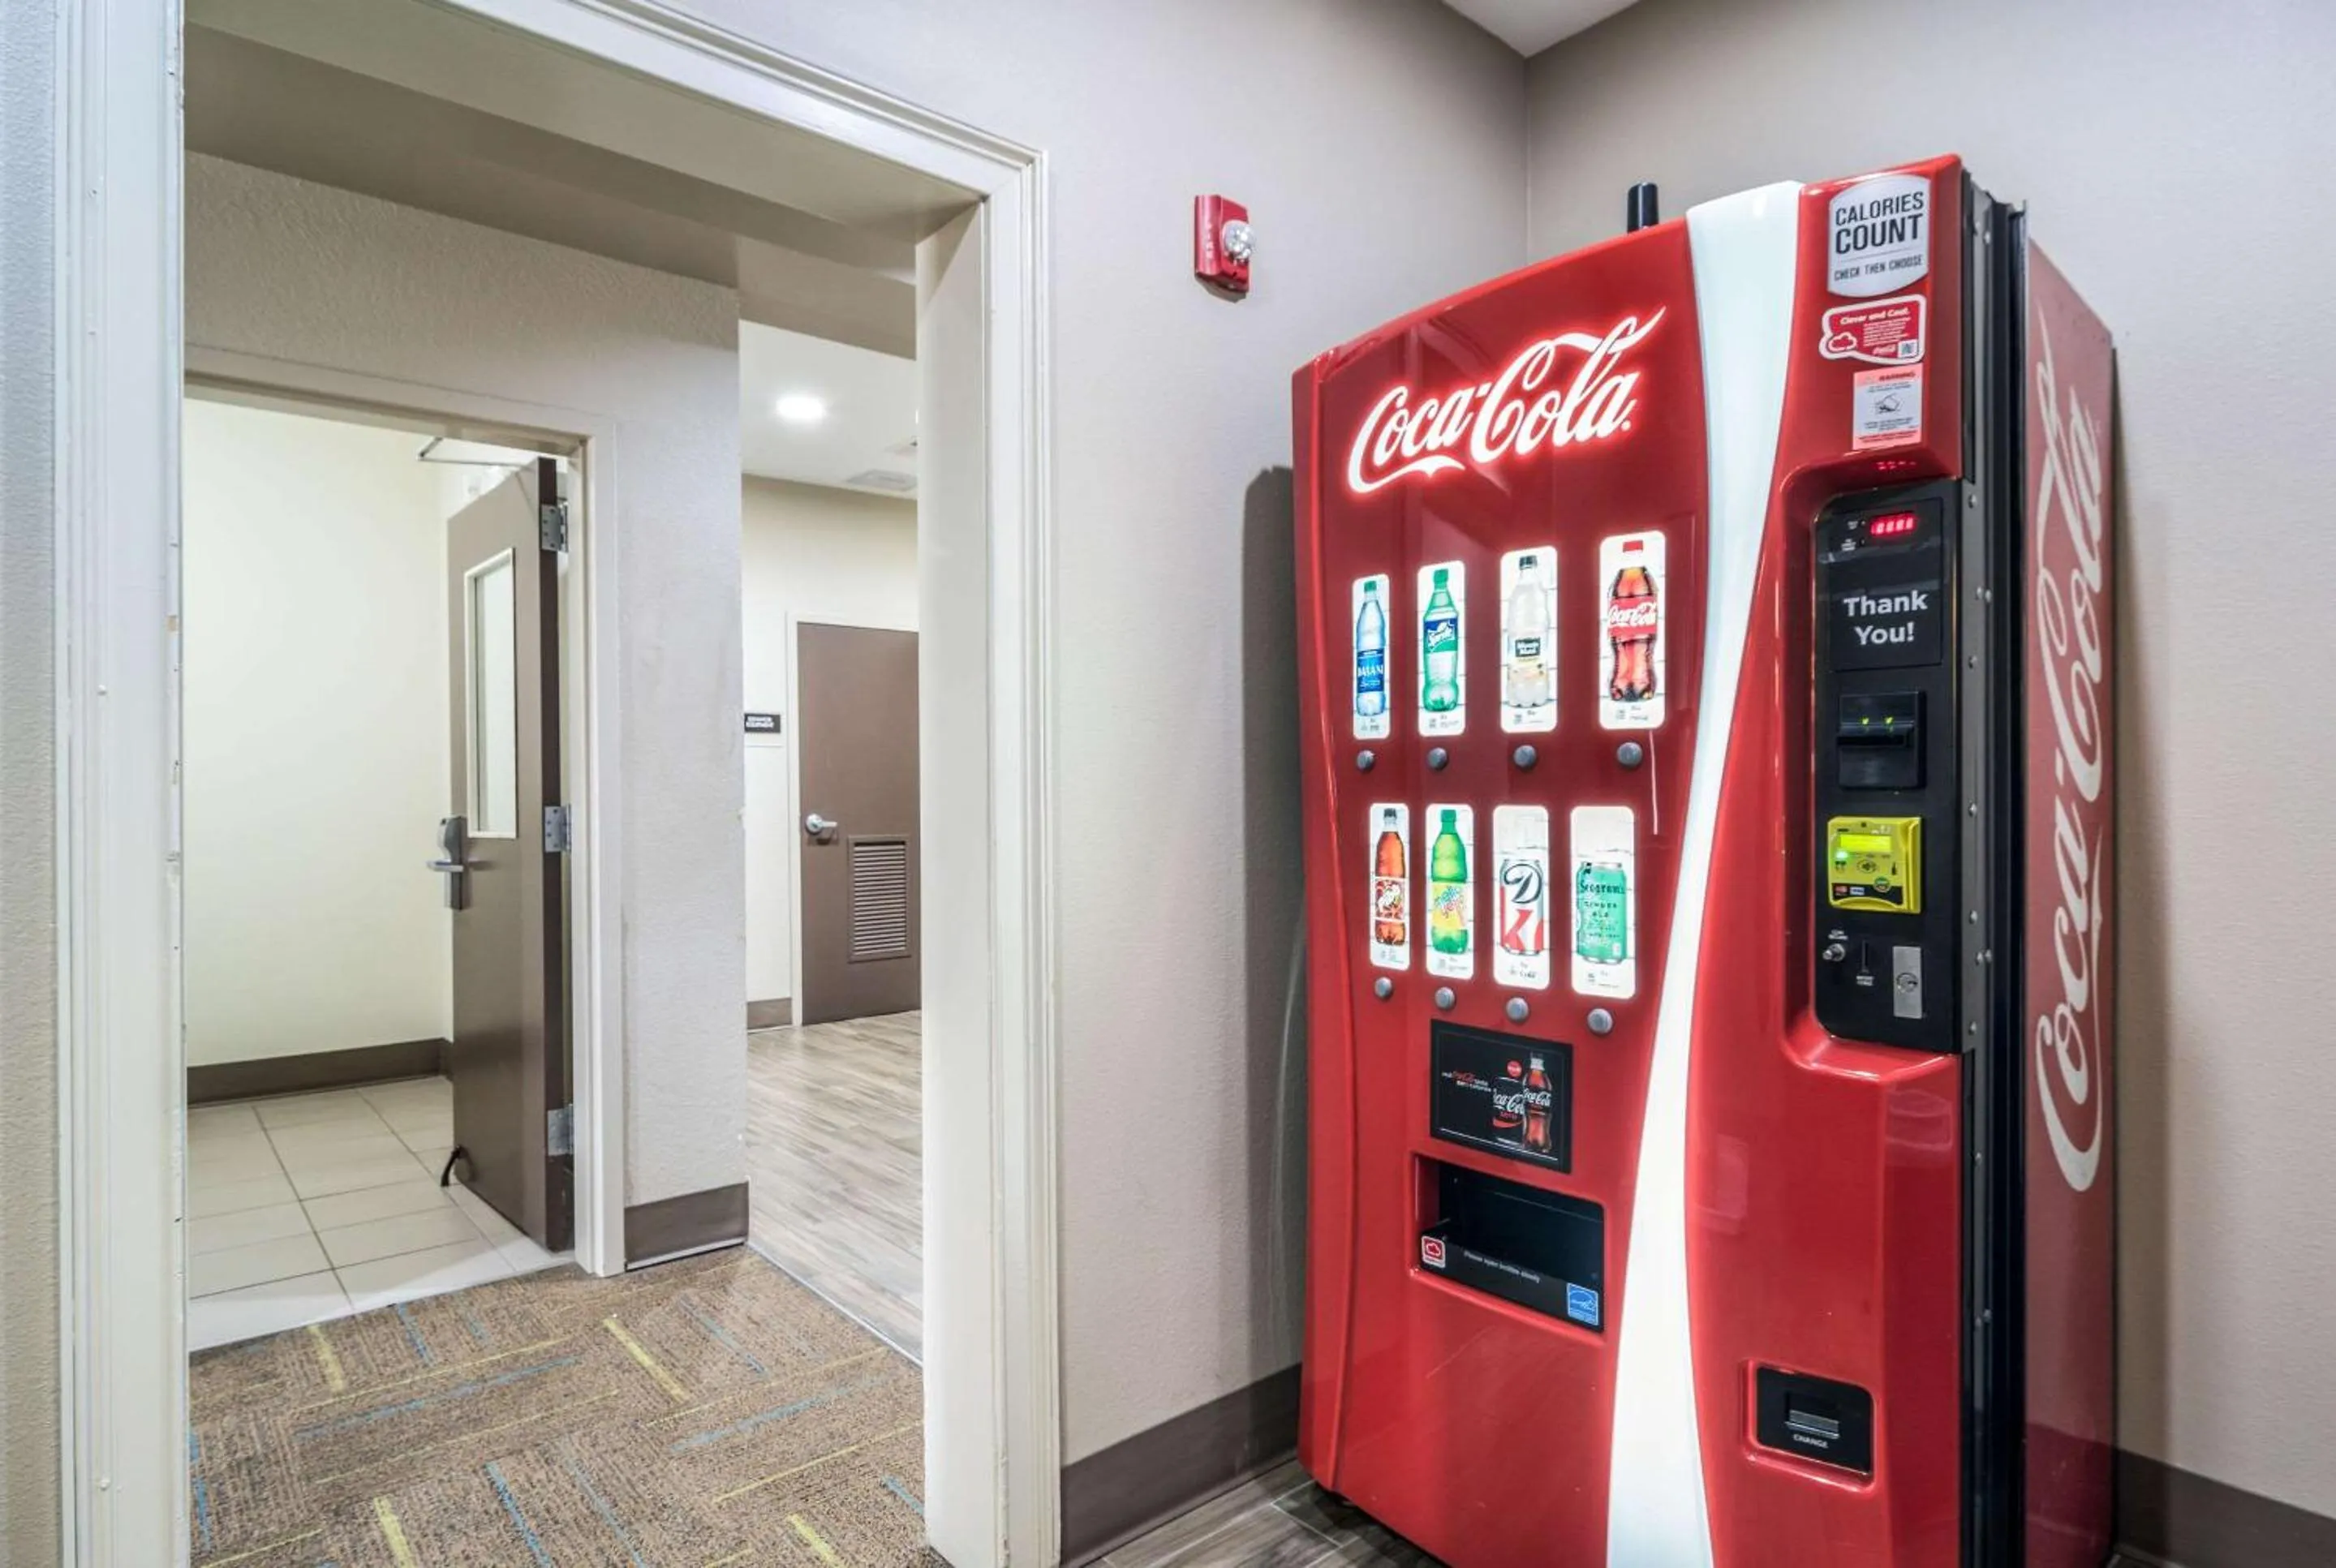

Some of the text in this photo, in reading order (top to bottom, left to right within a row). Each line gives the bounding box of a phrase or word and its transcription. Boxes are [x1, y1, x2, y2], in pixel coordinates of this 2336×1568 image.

[1835, 191, 1924, 226] CALORIES
[1835, 213, 1923, 255] COUNT
[1835, 255, 1923, 281] CHECK THEN CHOOSE
[1348, 306, 1667, 493] Coca-Cola
[1843, 590, 1929, 616] Thank
[1854, 621, 1915, 645] You!
[2036, 300, 2103, 1192] Coca-Cola
[1792, 1433, 1829, 1449] CHANGE
